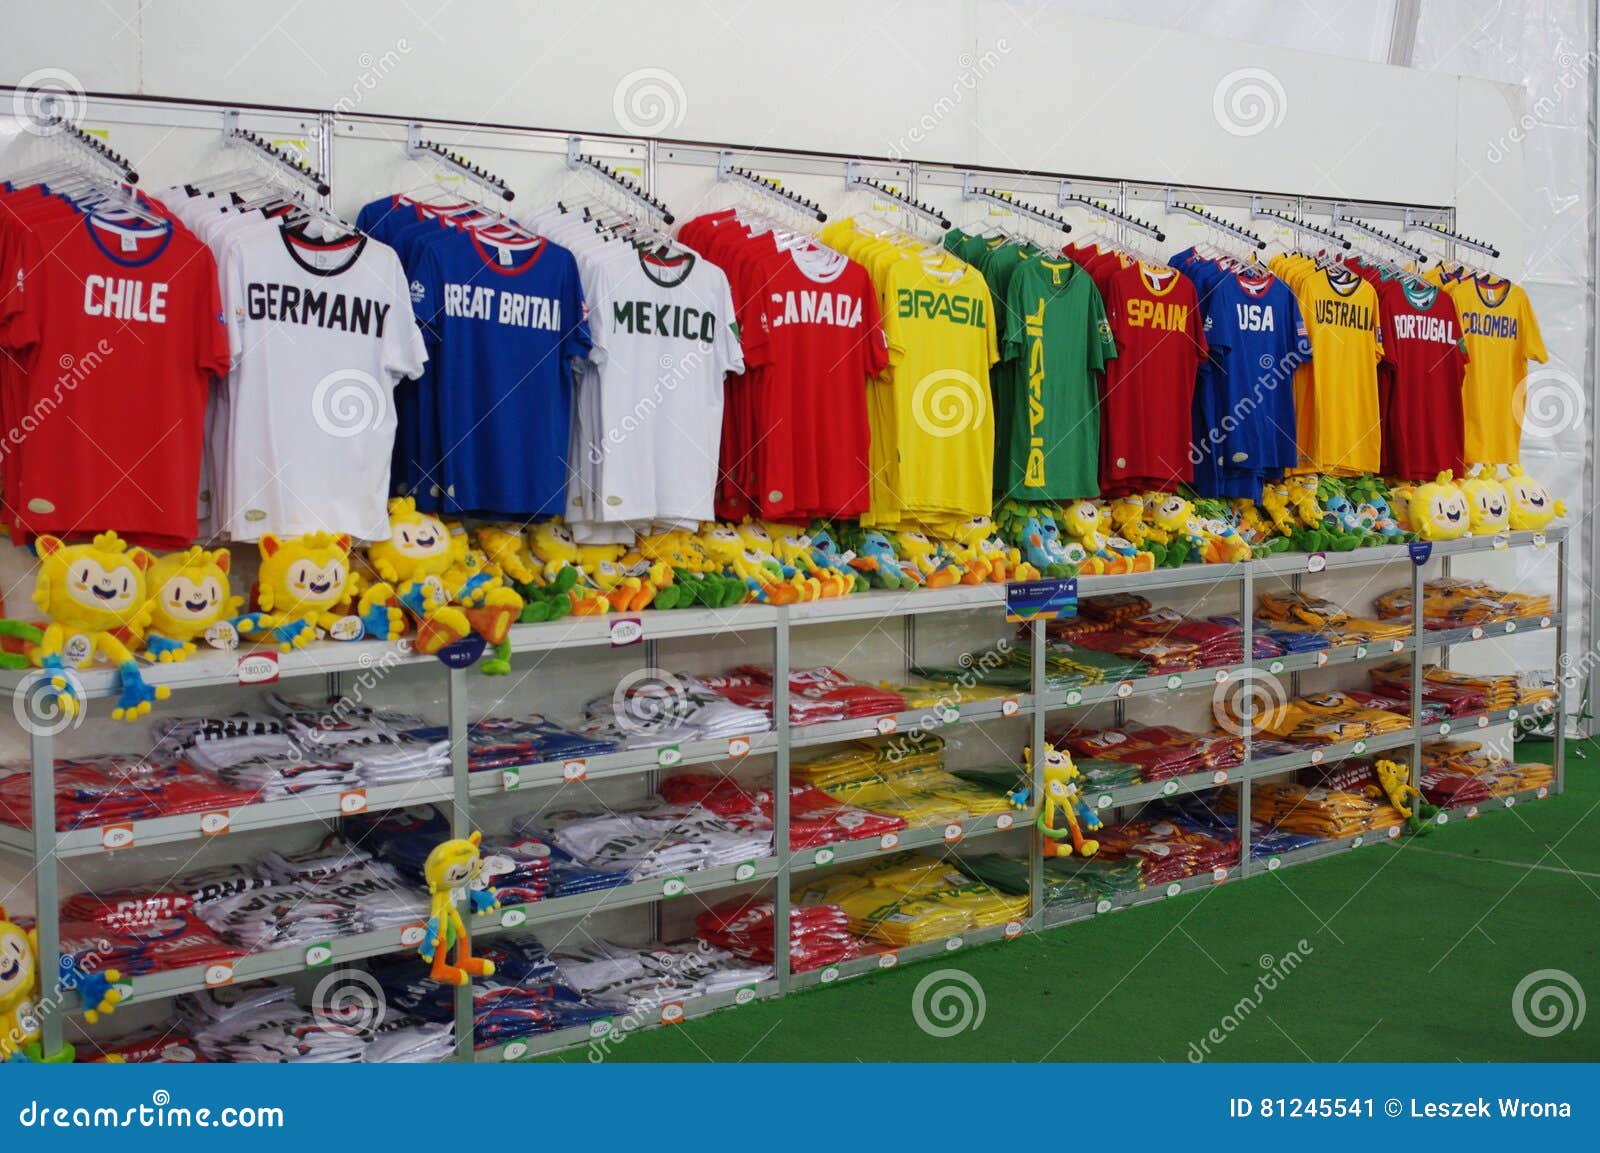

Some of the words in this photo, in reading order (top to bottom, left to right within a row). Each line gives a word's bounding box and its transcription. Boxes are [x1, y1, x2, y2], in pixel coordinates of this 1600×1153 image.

[84, 274, 168, 324] CHILE
[248, 282, 390, 338] GERMANY
[498, 290, 560, 331] BRITAI
[771, 290, 862, 328] CANADA
[897, 288, 986, 329] BRASIL
[1127, 298, 1188, 333] SPAIN
[1236, 303, 1275, 332] USA
[613, 301, 716, 343] MEXICO
[1462, 312, 1518, 340] COLOMBIA
[113, 833, 125, 841] PP
